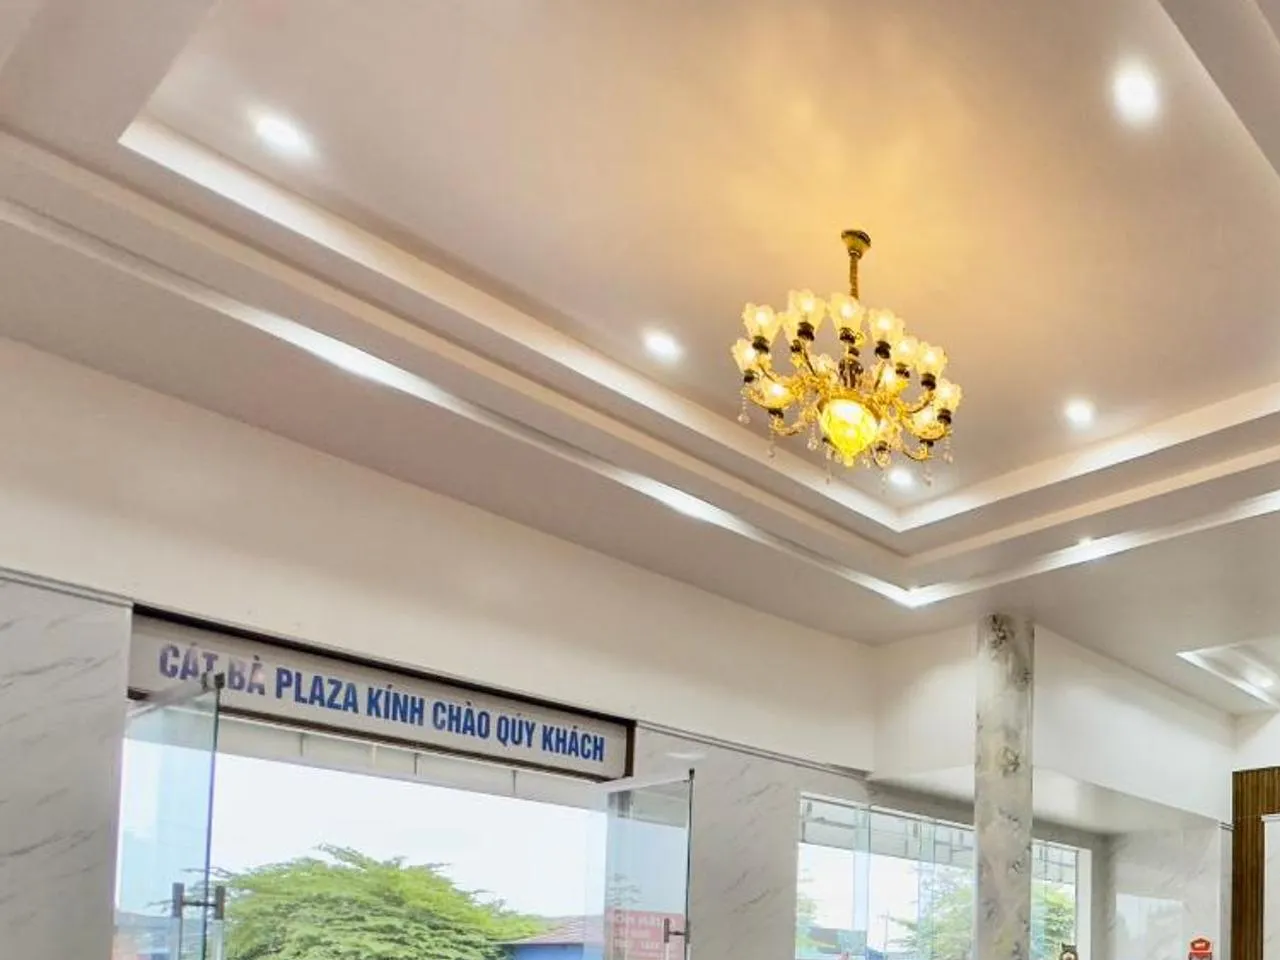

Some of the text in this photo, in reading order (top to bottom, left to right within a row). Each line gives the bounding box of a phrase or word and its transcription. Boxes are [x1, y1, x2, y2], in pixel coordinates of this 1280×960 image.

[275, 667, 359, 714] PLAZA
[366, 684, 425, 726] KÍNH
[432, 701, 491, 739] CHÀO
[541, 725, 604, 762] KHÁCH
